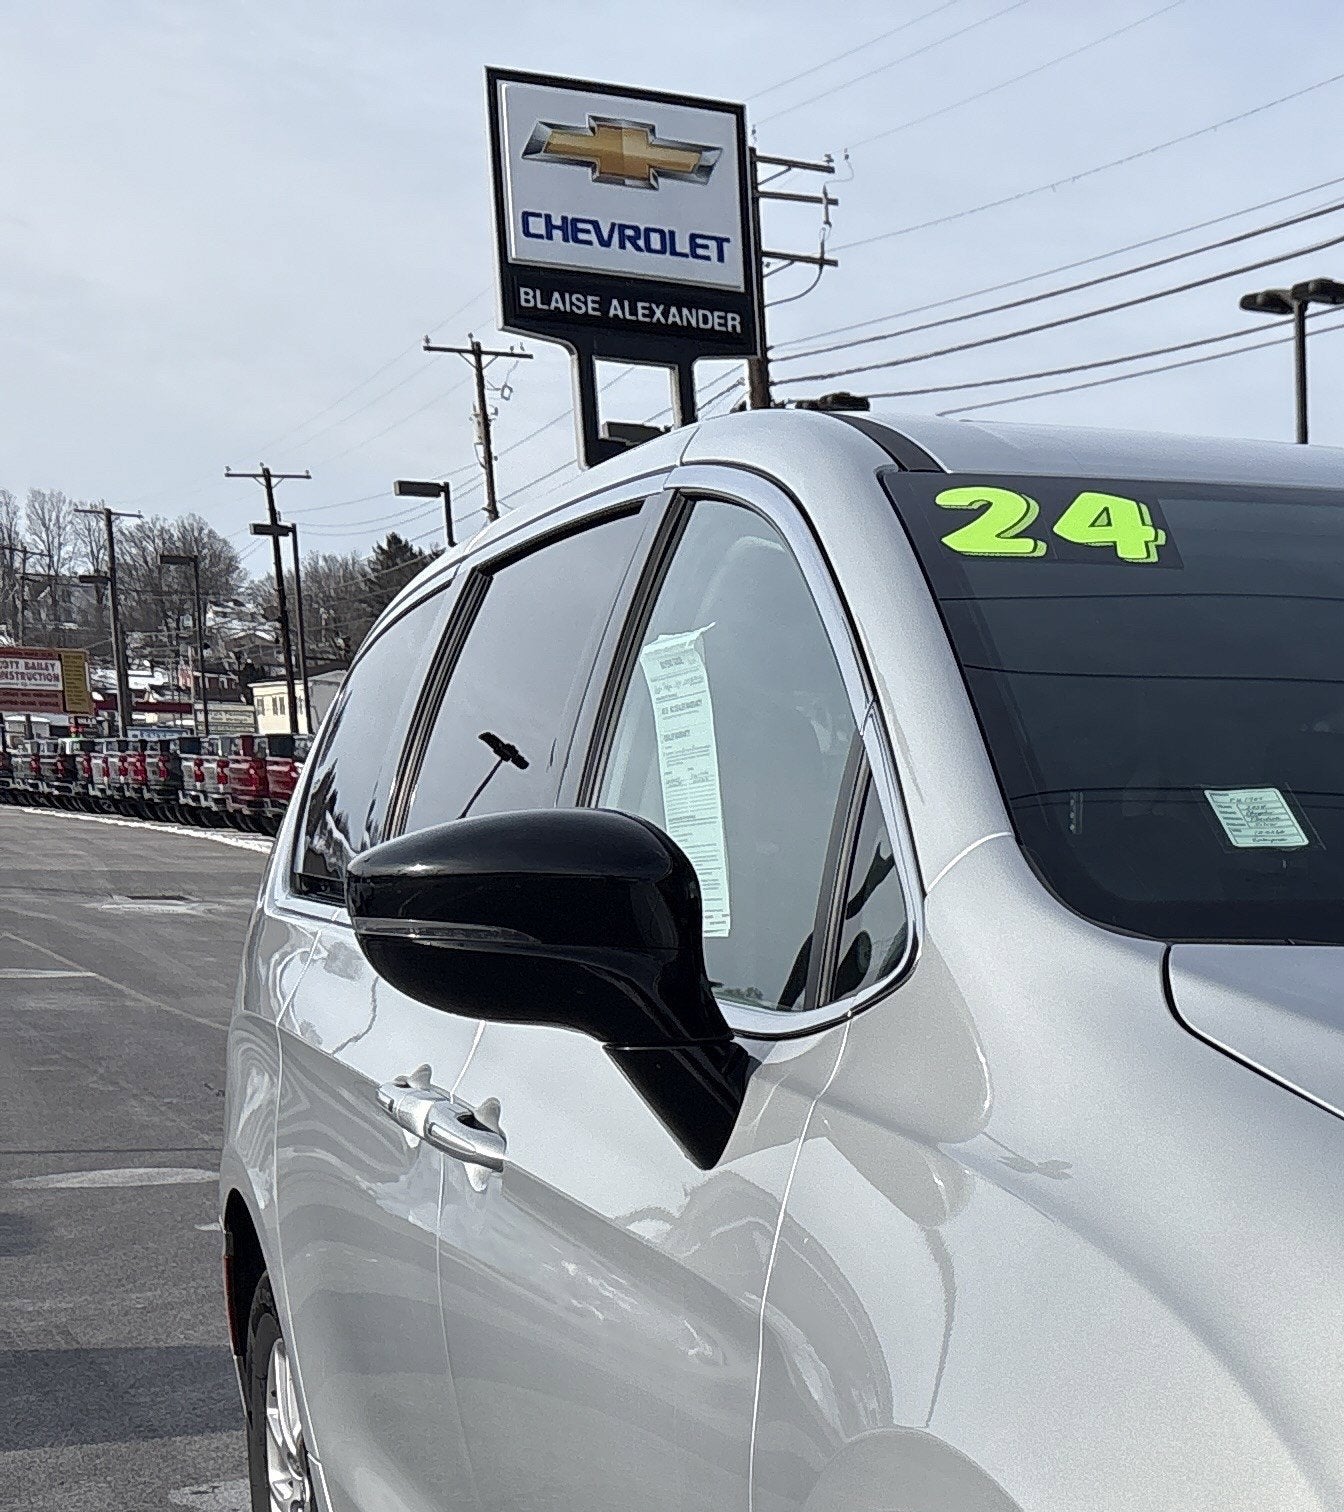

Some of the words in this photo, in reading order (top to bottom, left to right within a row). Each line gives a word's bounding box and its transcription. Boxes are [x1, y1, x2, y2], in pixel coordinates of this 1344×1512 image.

[521, 210, 731, 264] CHEVROLET
[519, 287, 602, 317] BLAISE
[608, 298, 742, 334] ALEXANDER
[934, 484, 1167, 564] 24
